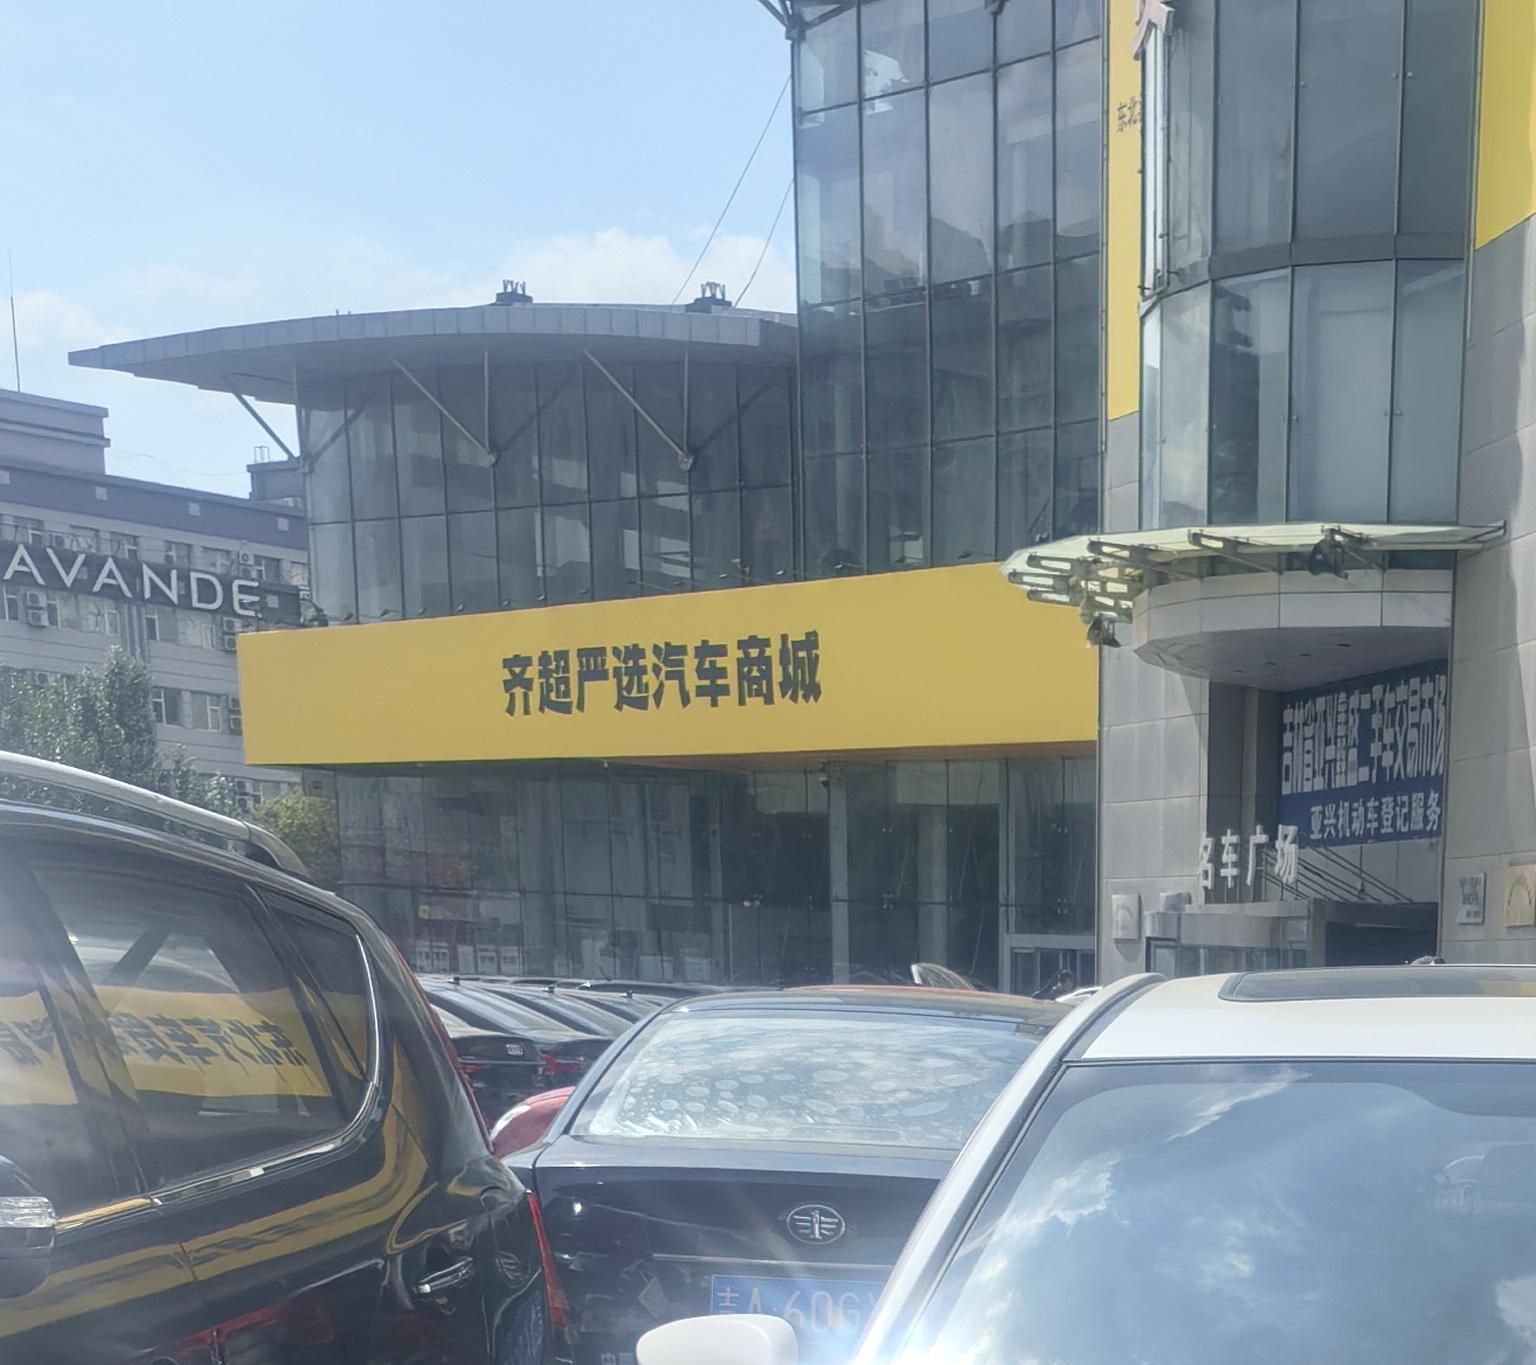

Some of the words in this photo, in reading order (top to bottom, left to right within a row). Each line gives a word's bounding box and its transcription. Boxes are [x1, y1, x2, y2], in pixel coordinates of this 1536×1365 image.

[502, 630, 822, 717] 齐超严选汽车商城
